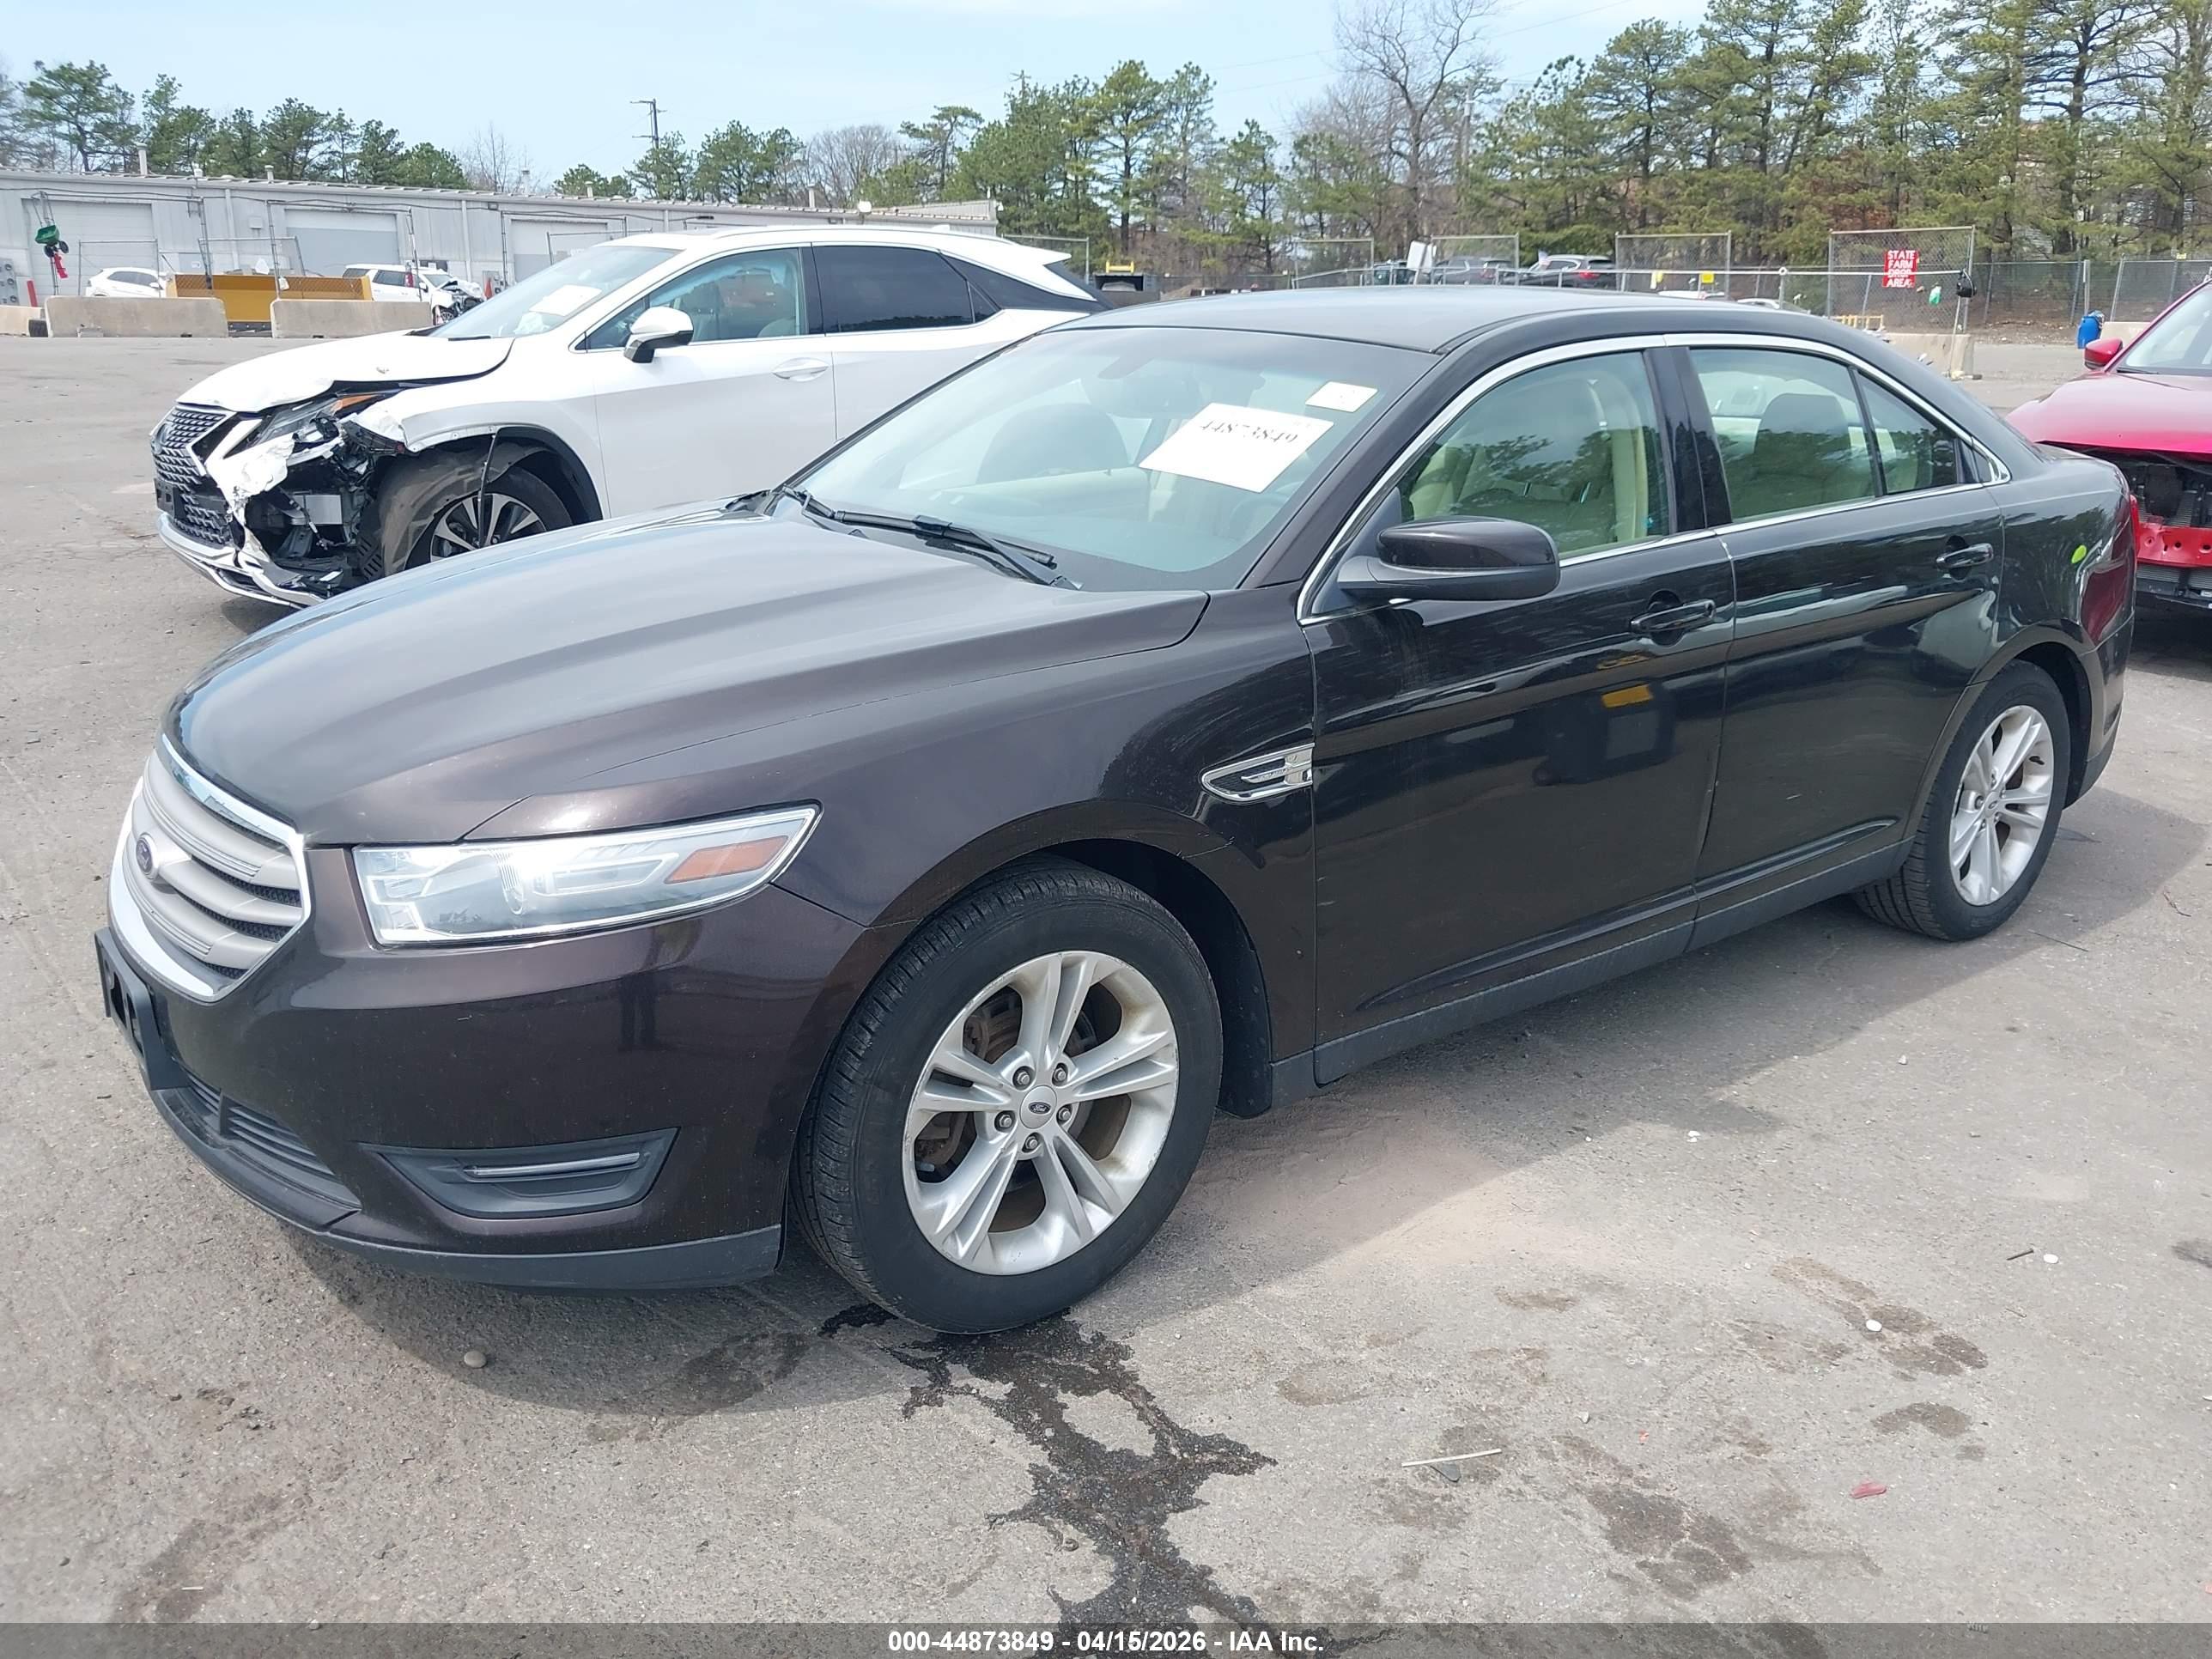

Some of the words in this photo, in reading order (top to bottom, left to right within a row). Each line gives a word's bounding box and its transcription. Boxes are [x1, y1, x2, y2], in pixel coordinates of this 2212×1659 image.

[1887, 250, 1915, 259] STATE
[1888, 259, 1913, 269] FARM
[1887, 269, 1911, 278] DROP
[1886, 278, 1913, 288] AREA
[1200, 418, 1298, 444] 4483849
